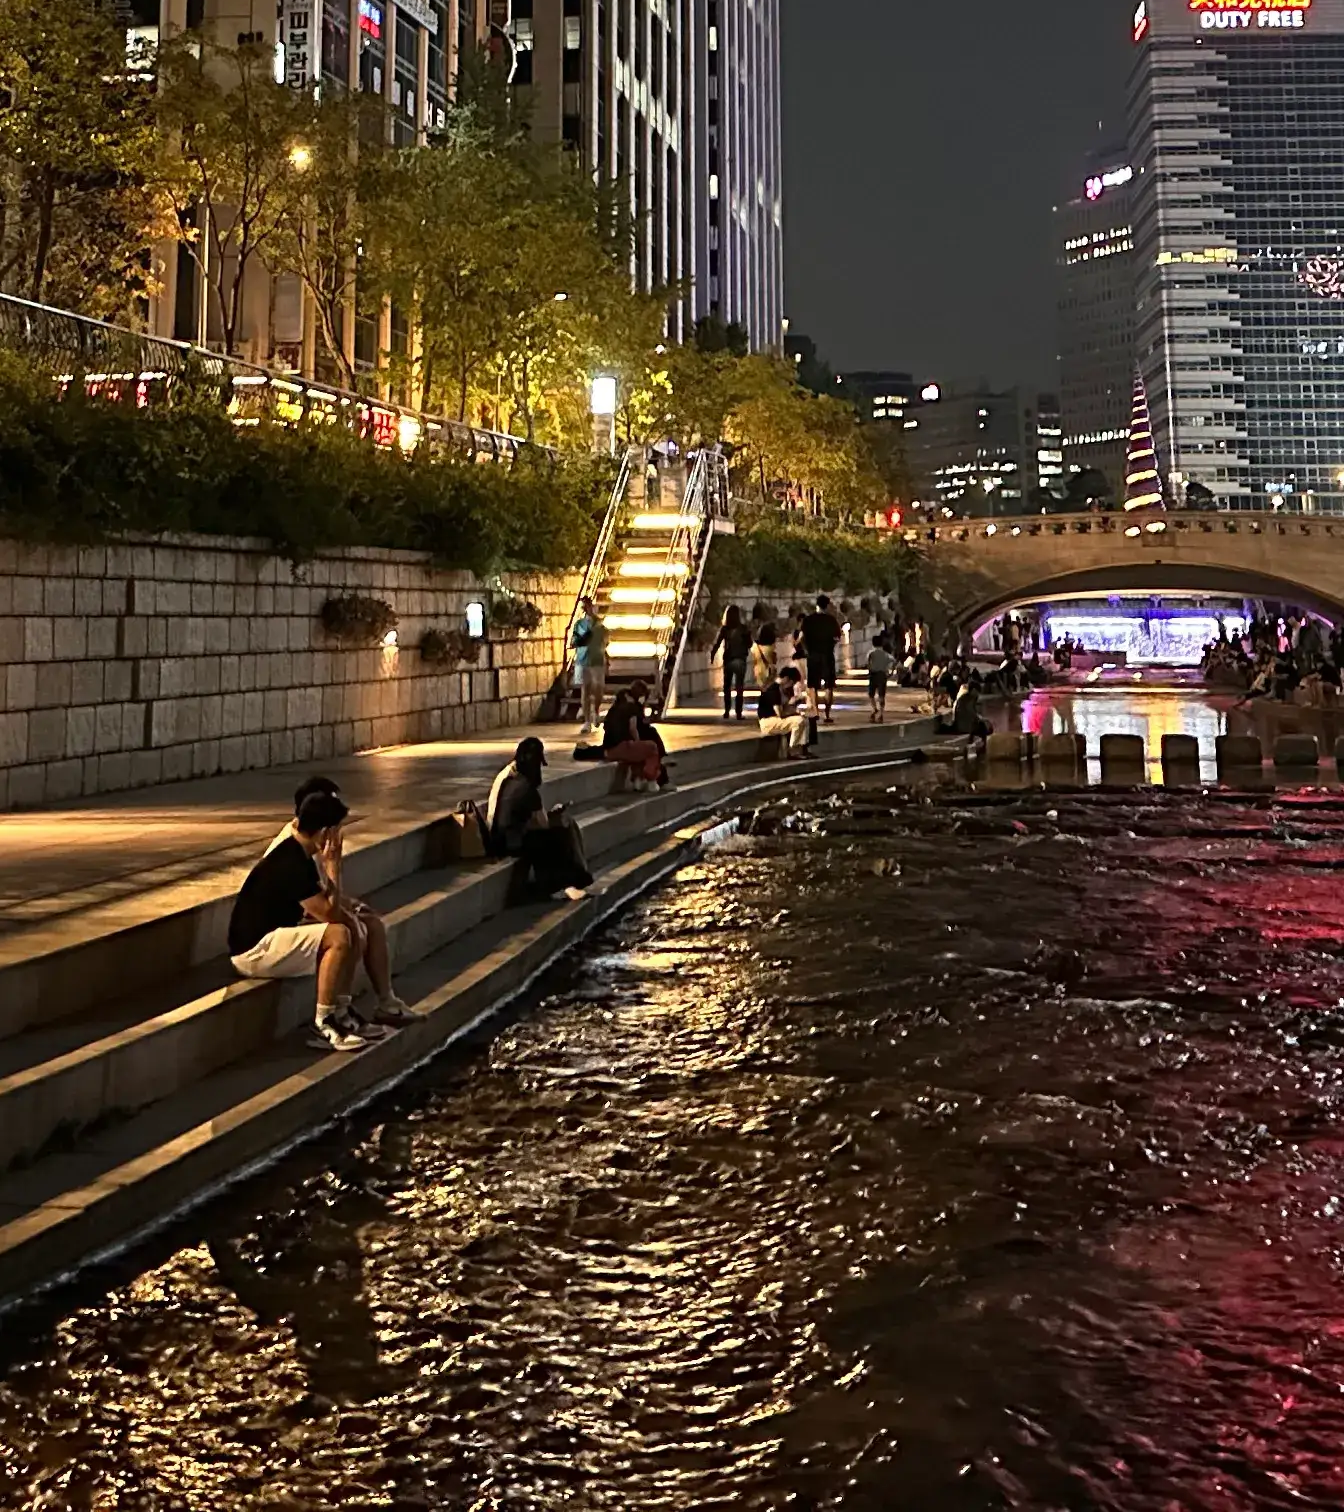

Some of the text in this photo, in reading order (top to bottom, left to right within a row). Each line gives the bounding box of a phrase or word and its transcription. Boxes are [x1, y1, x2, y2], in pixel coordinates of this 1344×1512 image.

[1200, 10, 1304, 28] DUTY FREE
[289, 11, 309, 90] 피부관리
